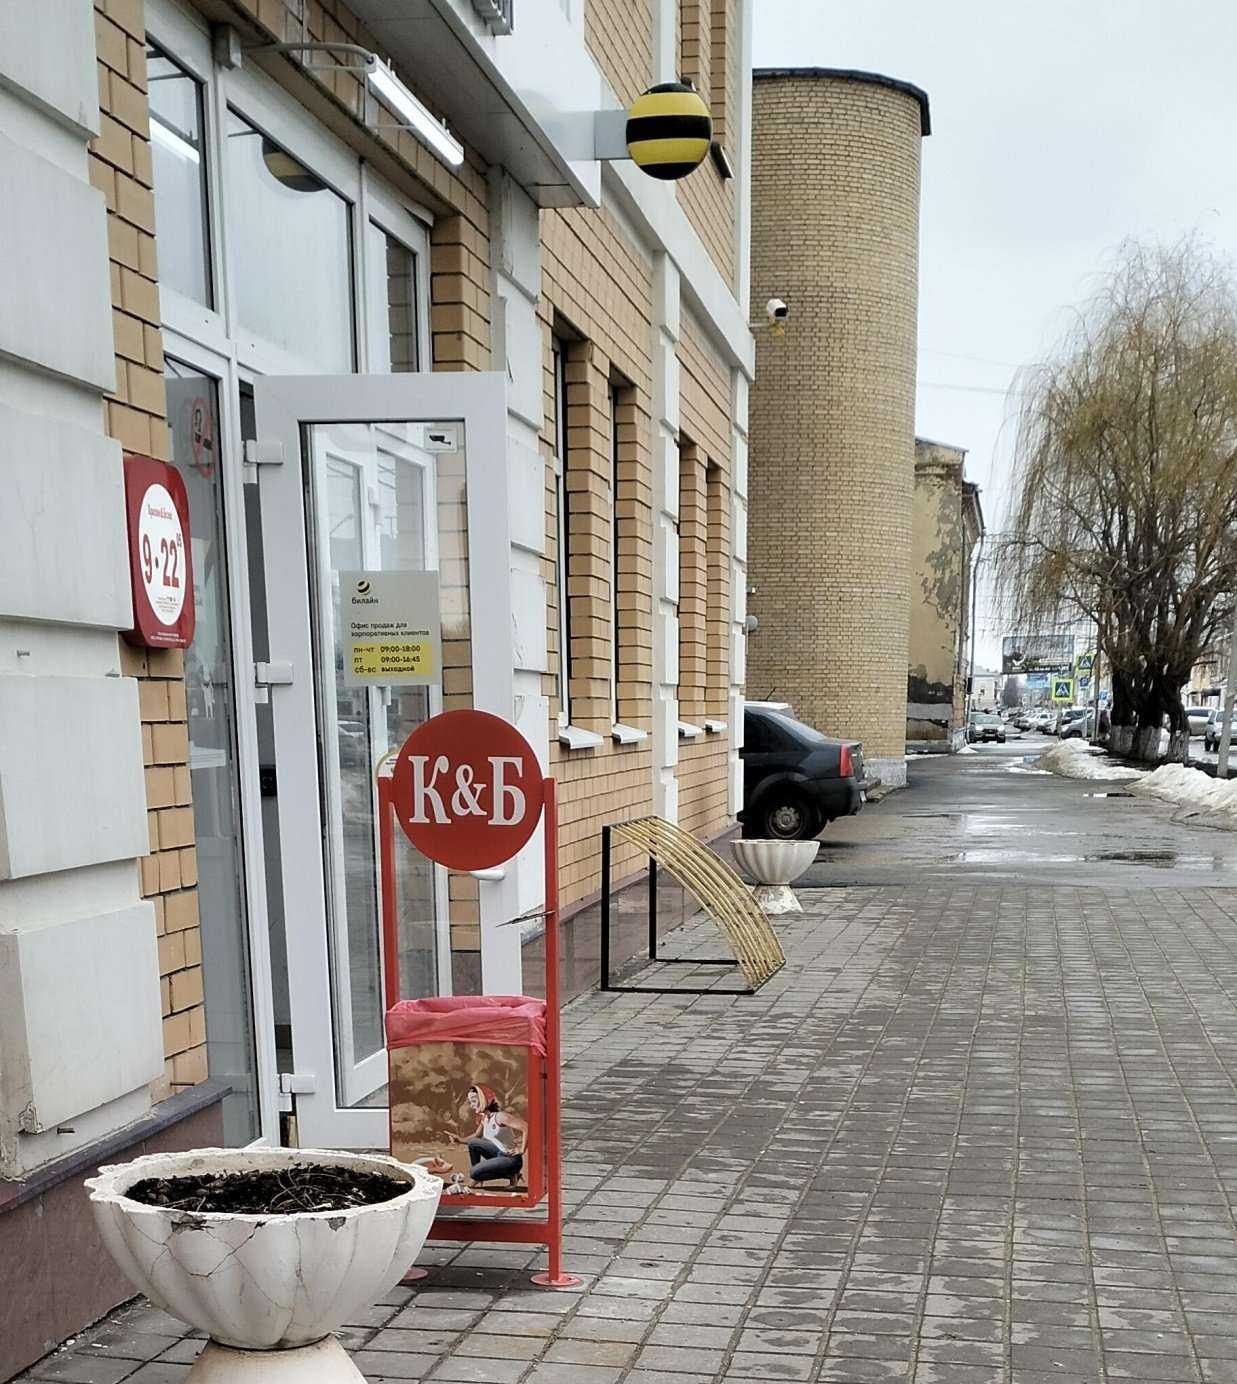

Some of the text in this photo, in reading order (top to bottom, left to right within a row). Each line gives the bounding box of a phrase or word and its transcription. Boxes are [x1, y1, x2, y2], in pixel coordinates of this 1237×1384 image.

[351, 596, 379, 605] билайн
[350, 622, 369, 630] Офис
[380, 645, 421, 653] 09:00-18:00
[380, 655, 421, 664] 09:00-16:45
[354, 665, 415, 673] сб-вс выходной
[408, 755, 526, 825] К&Б
